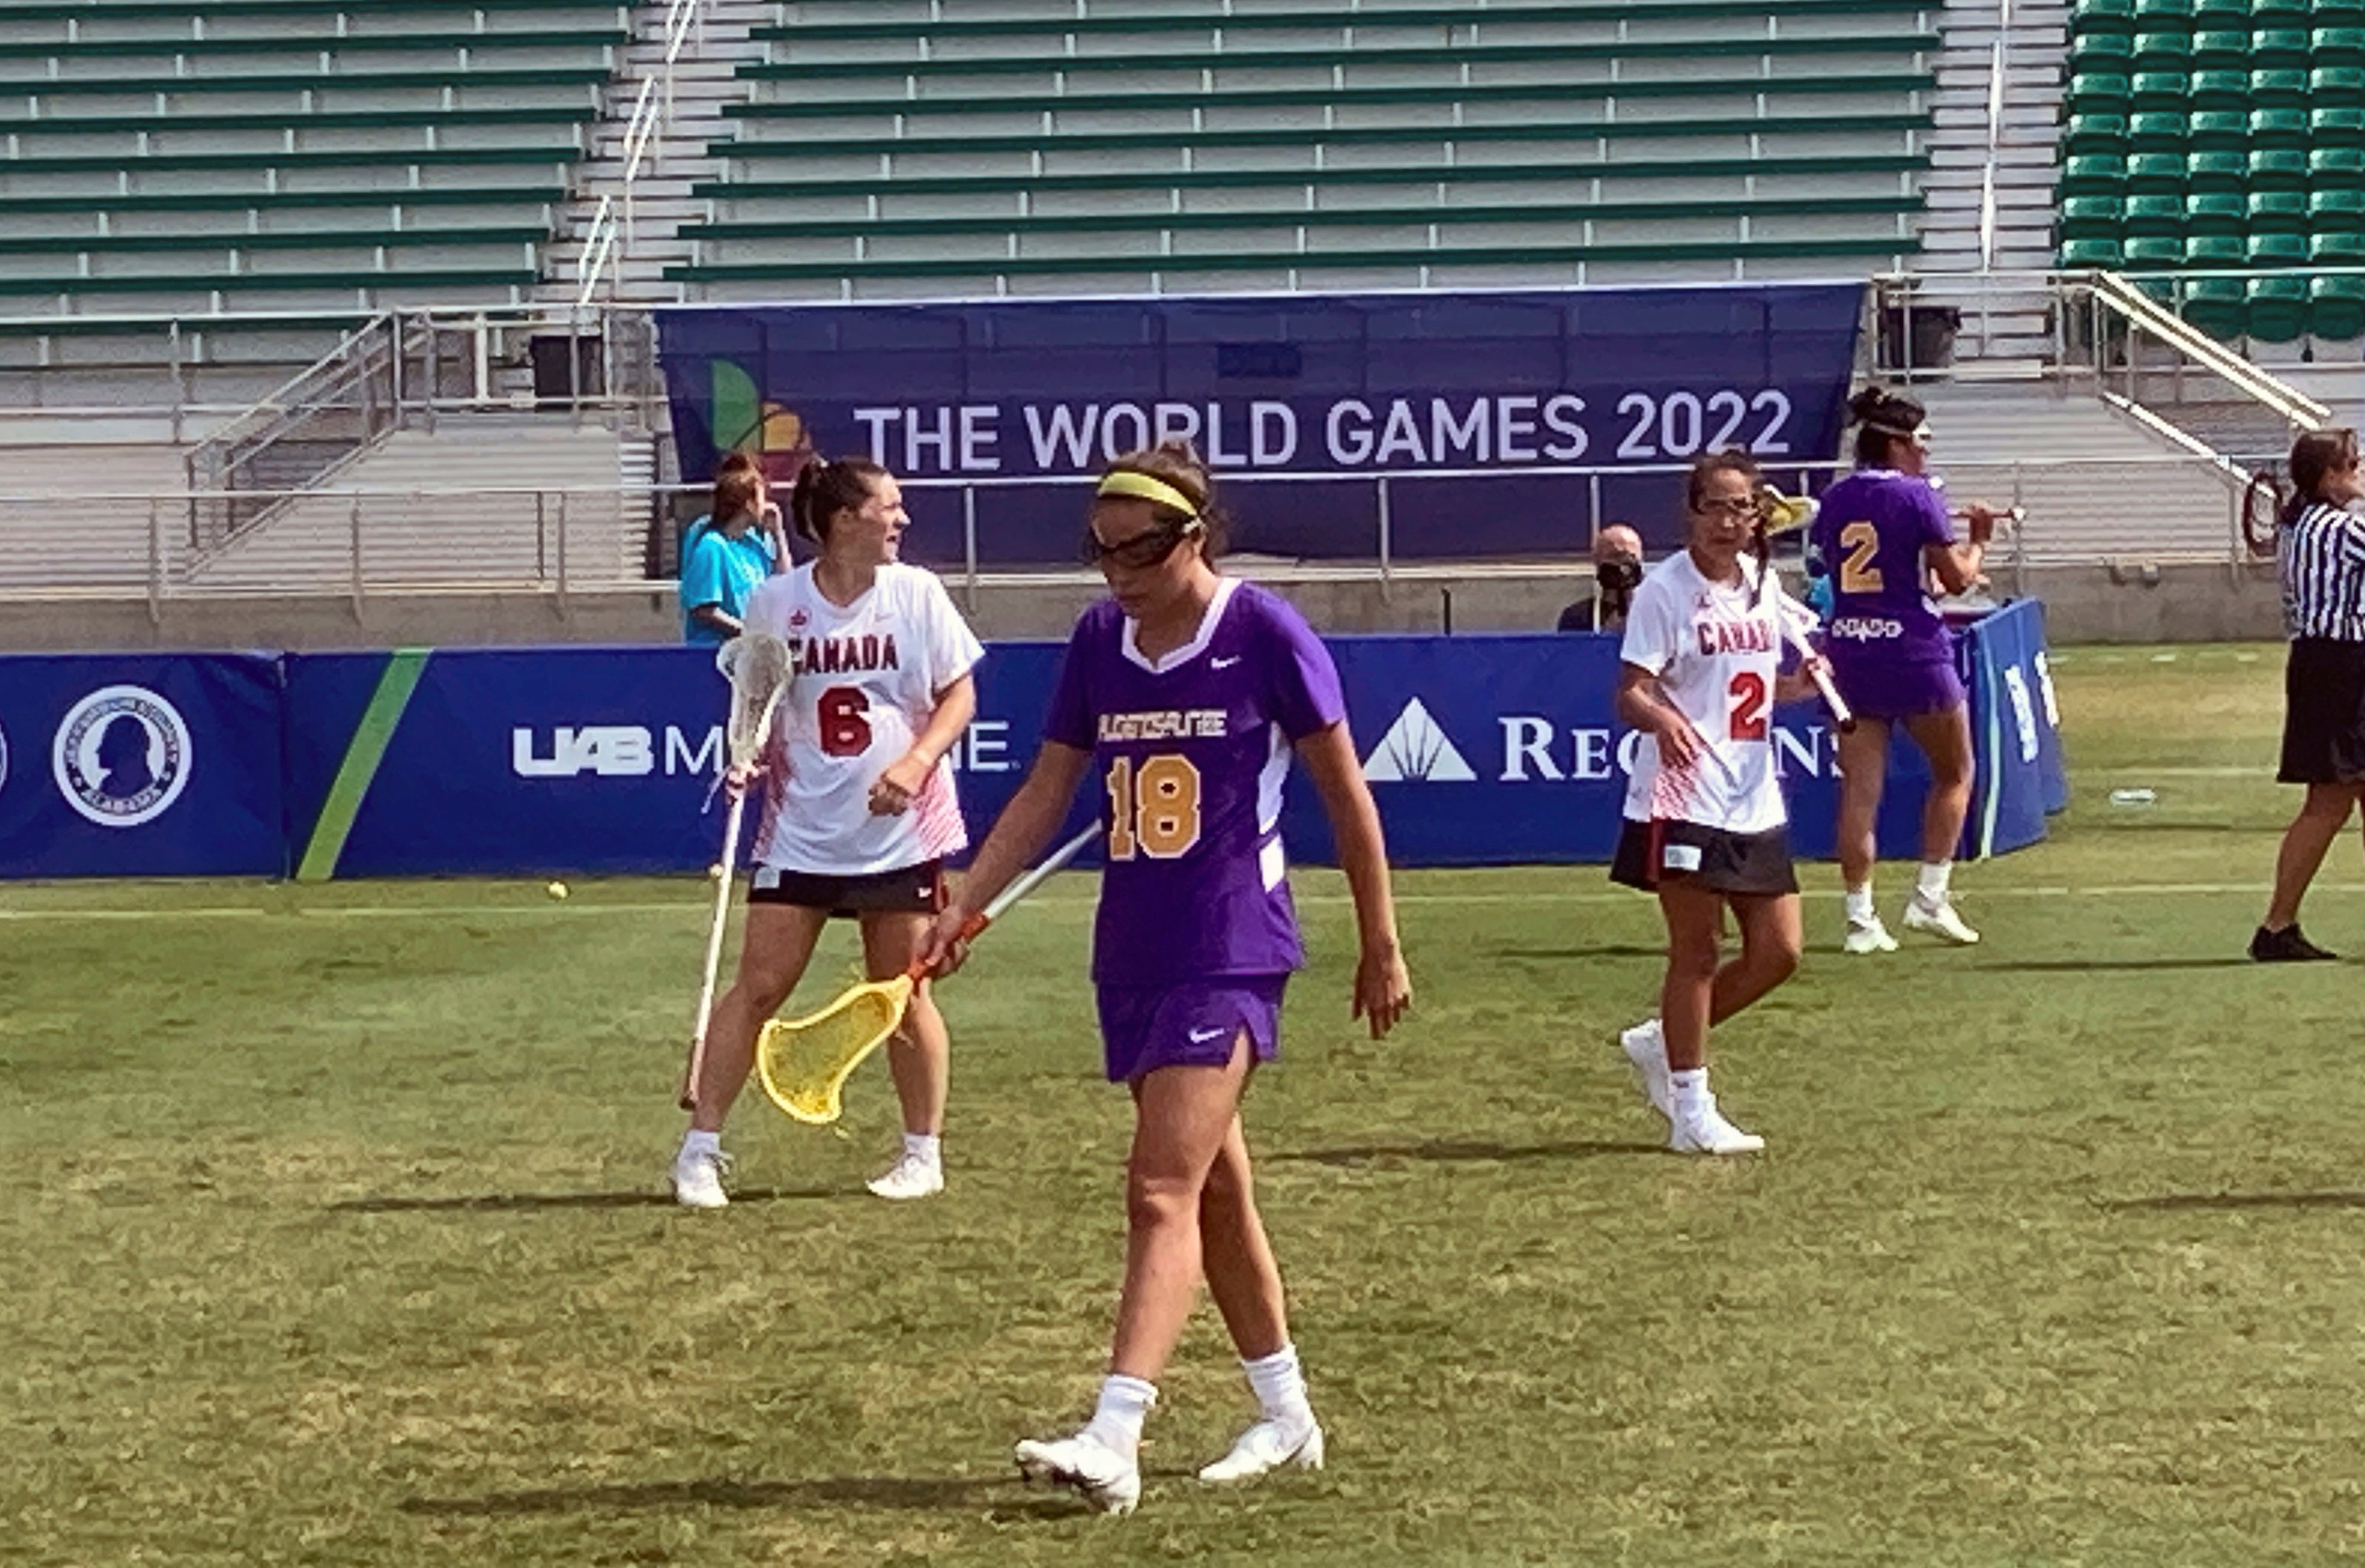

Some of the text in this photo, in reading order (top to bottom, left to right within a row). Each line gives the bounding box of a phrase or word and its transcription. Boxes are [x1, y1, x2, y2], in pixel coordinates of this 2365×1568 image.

[854, 391, 1791, 470] THE WORLD GAMES 2022
[1840, 520, 1884, 593] 2
[818, 686, 873, 757] 6
[1728, 672, 1767, 742] 2
[513, 726, 655, 777] UAB
[1106, 754, 1201, 862] 18
